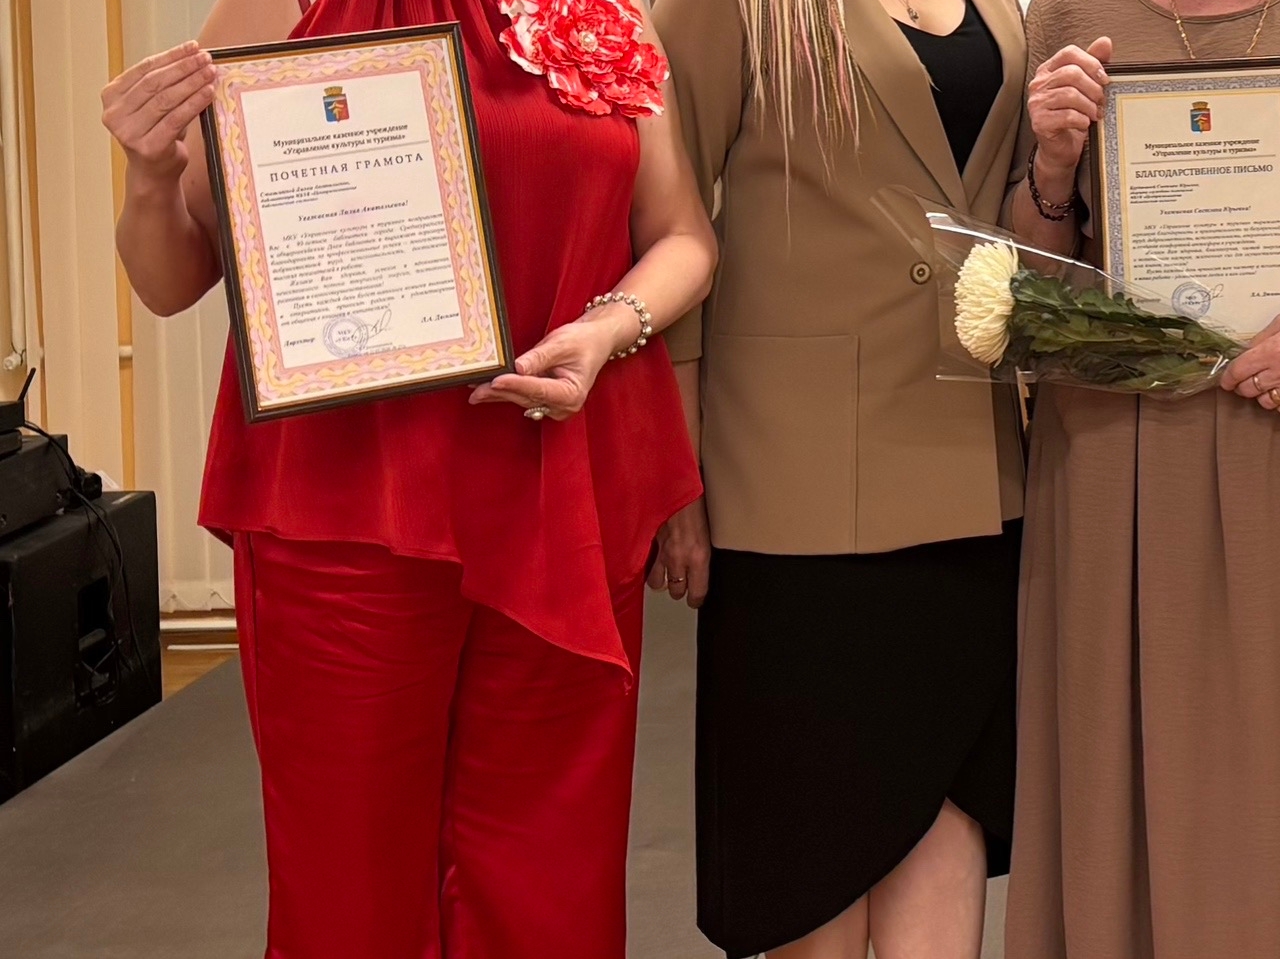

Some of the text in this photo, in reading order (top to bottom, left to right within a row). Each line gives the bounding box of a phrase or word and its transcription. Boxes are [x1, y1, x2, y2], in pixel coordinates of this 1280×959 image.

[269, 152, 423, 182] ПОЧЕТНАЯ ГРАМОТА
[1135, 164, 1273, 178] БЛАГОДАРСТВЕННОЕ ПИСЬМО
